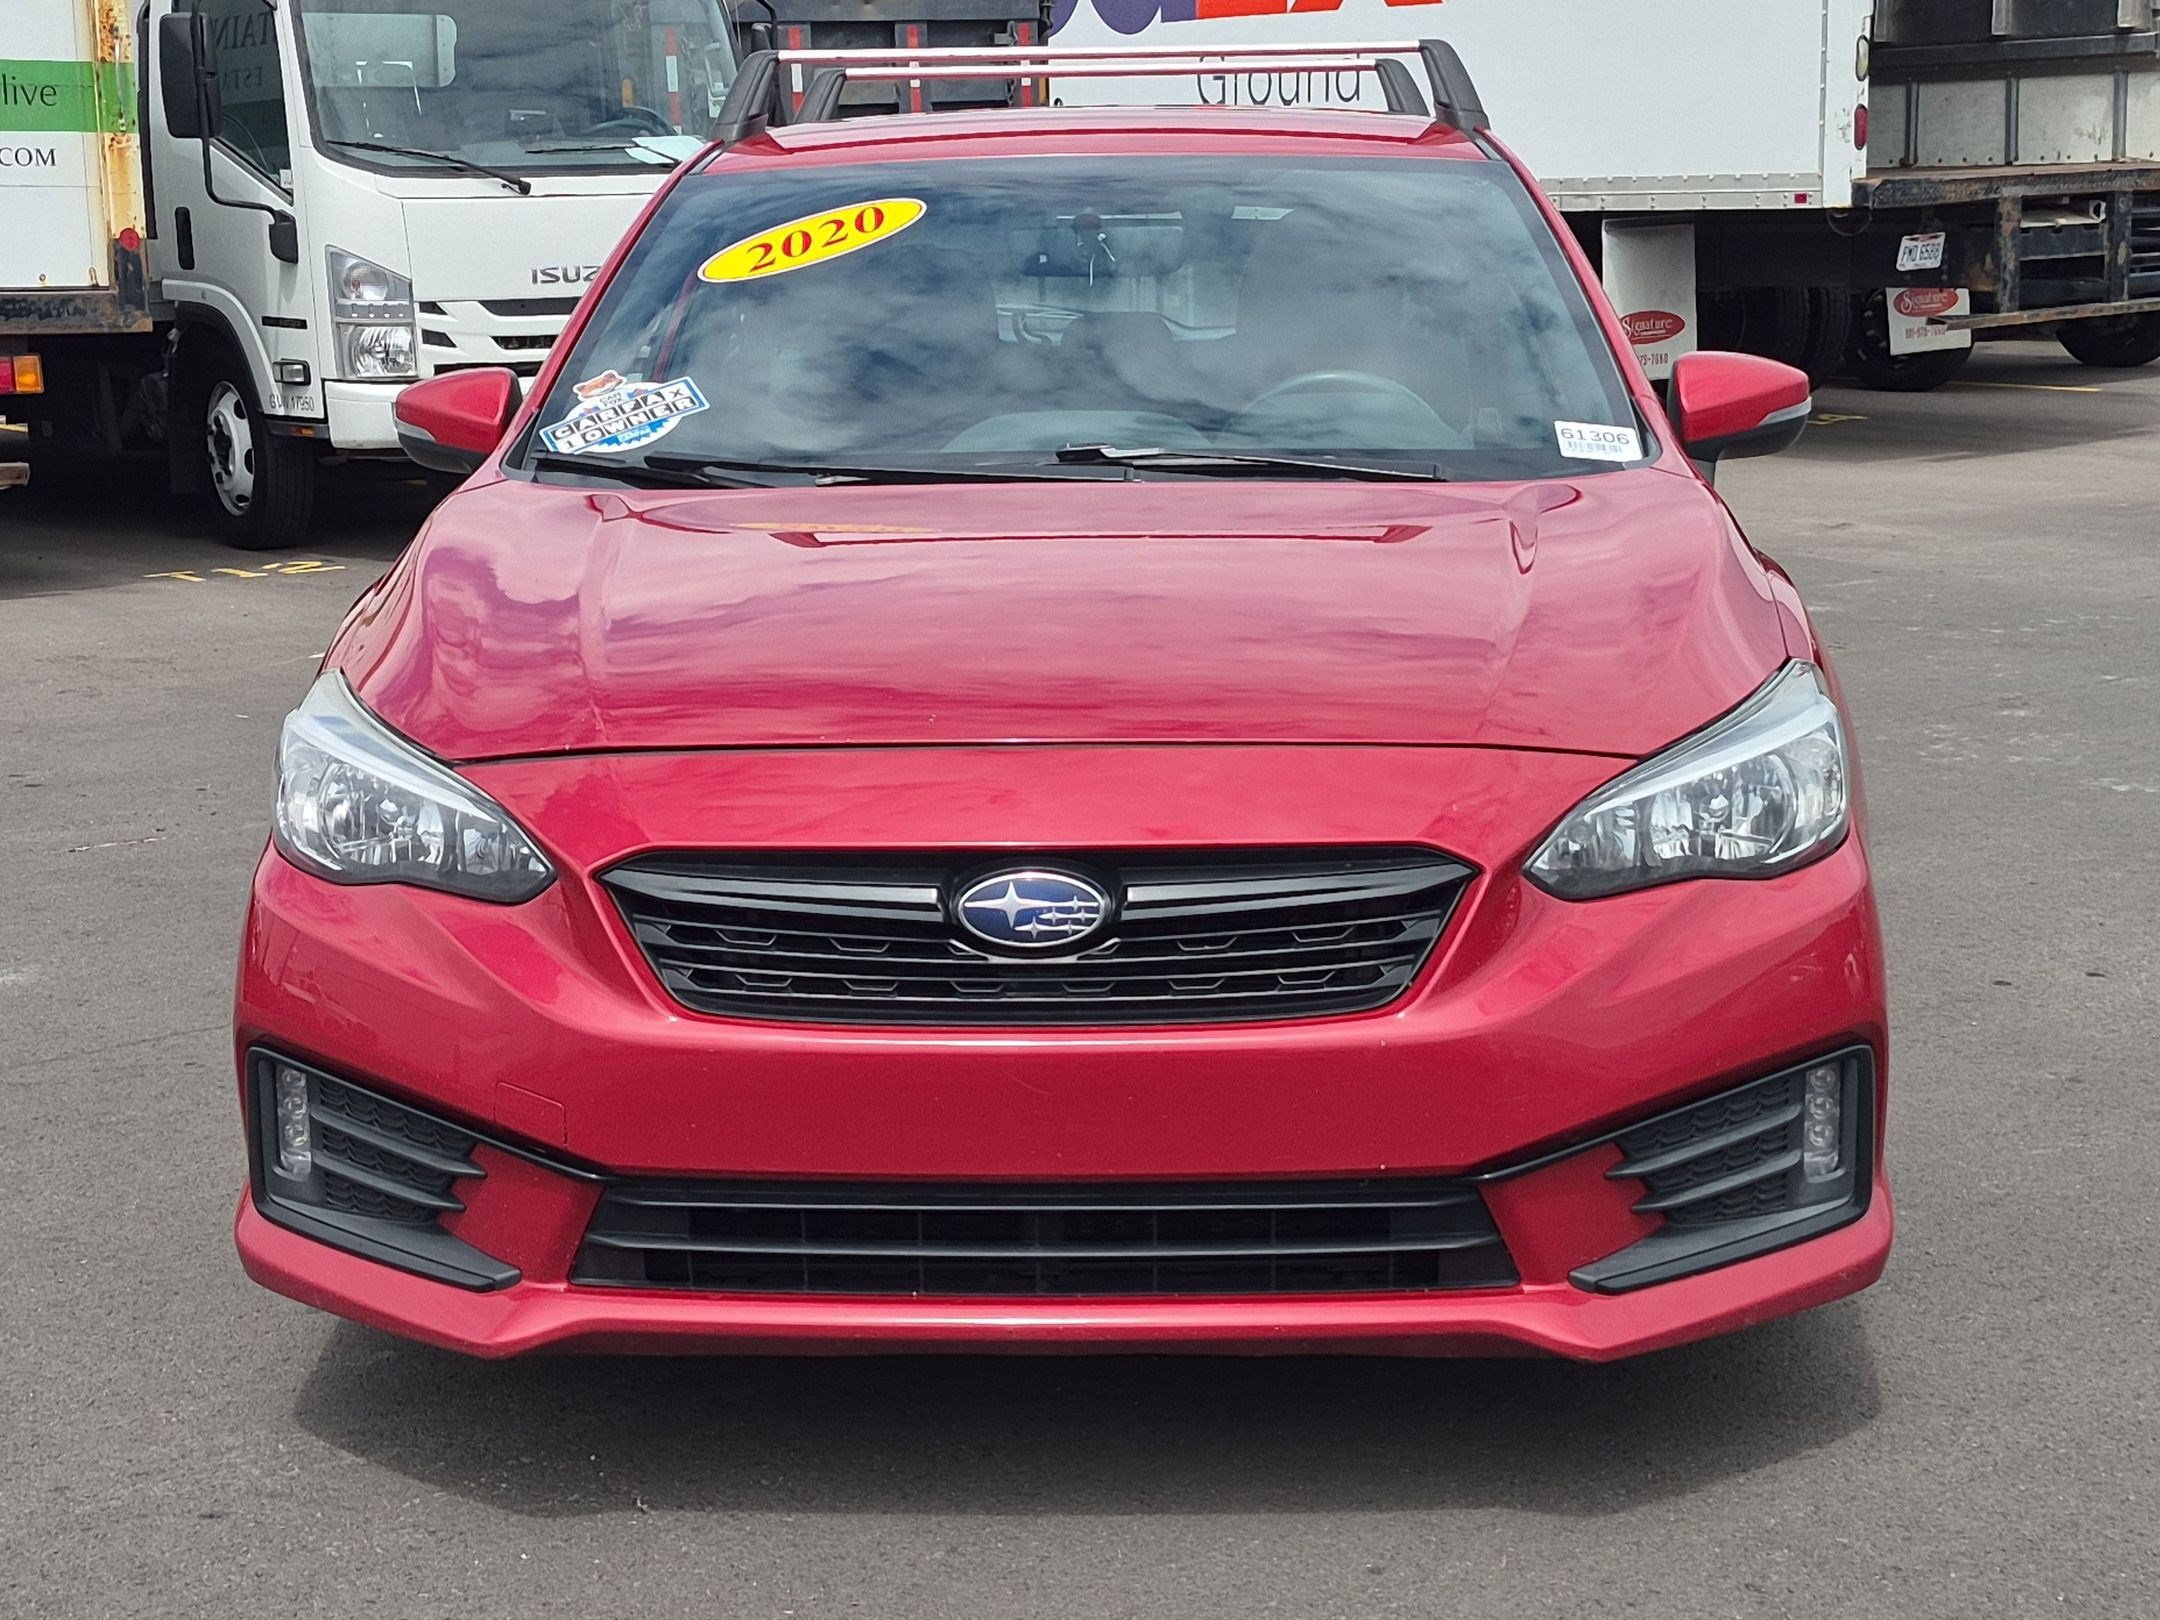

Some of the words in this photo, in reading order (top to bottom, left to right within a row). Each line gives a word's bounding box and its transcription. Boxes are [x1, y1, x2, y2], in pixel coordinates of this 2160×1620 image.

[2, 73, 57, 106] live
[1198, 53, 1361, 106] Ground
[747, 206, 884, 273] 2020
[1621, 316, 1673, 339] Signature
[551, 386, 685, 441] CARFAX
[563, 434, 576, 450] 1
[582, 396, 696, 444] OWNER
[1560, 427, 1630, 445] 61306
